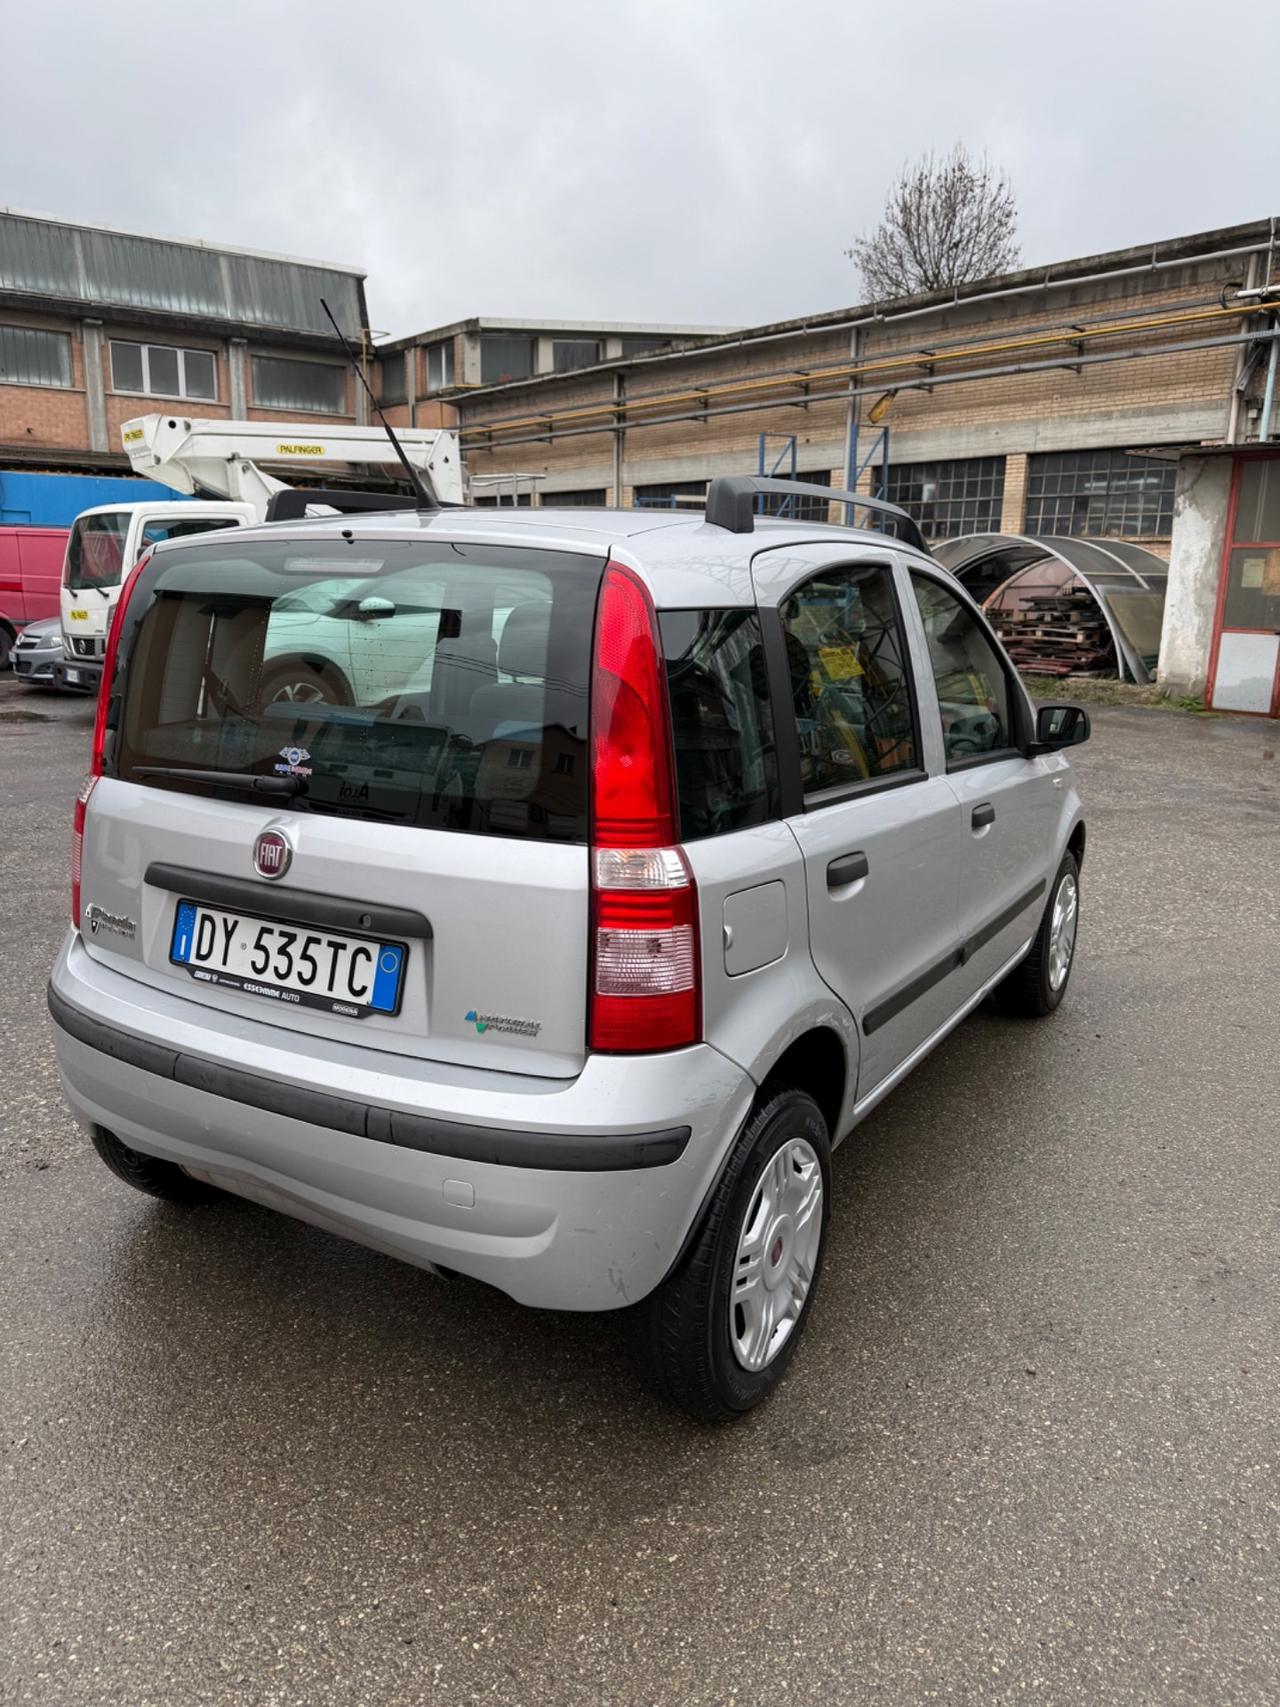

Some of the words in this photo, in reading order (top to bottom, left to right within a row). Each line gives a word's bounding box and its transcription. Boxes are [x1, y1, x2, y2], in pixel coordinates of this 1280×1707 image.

[279, 444, 322, 455] PALFINGER
[260, 843, 283, 868] FIAT
[195, 913, 239, 966] DY
[250, 926, 373, 998] 535TC
[281, 992, 300, 1002] AUTO
